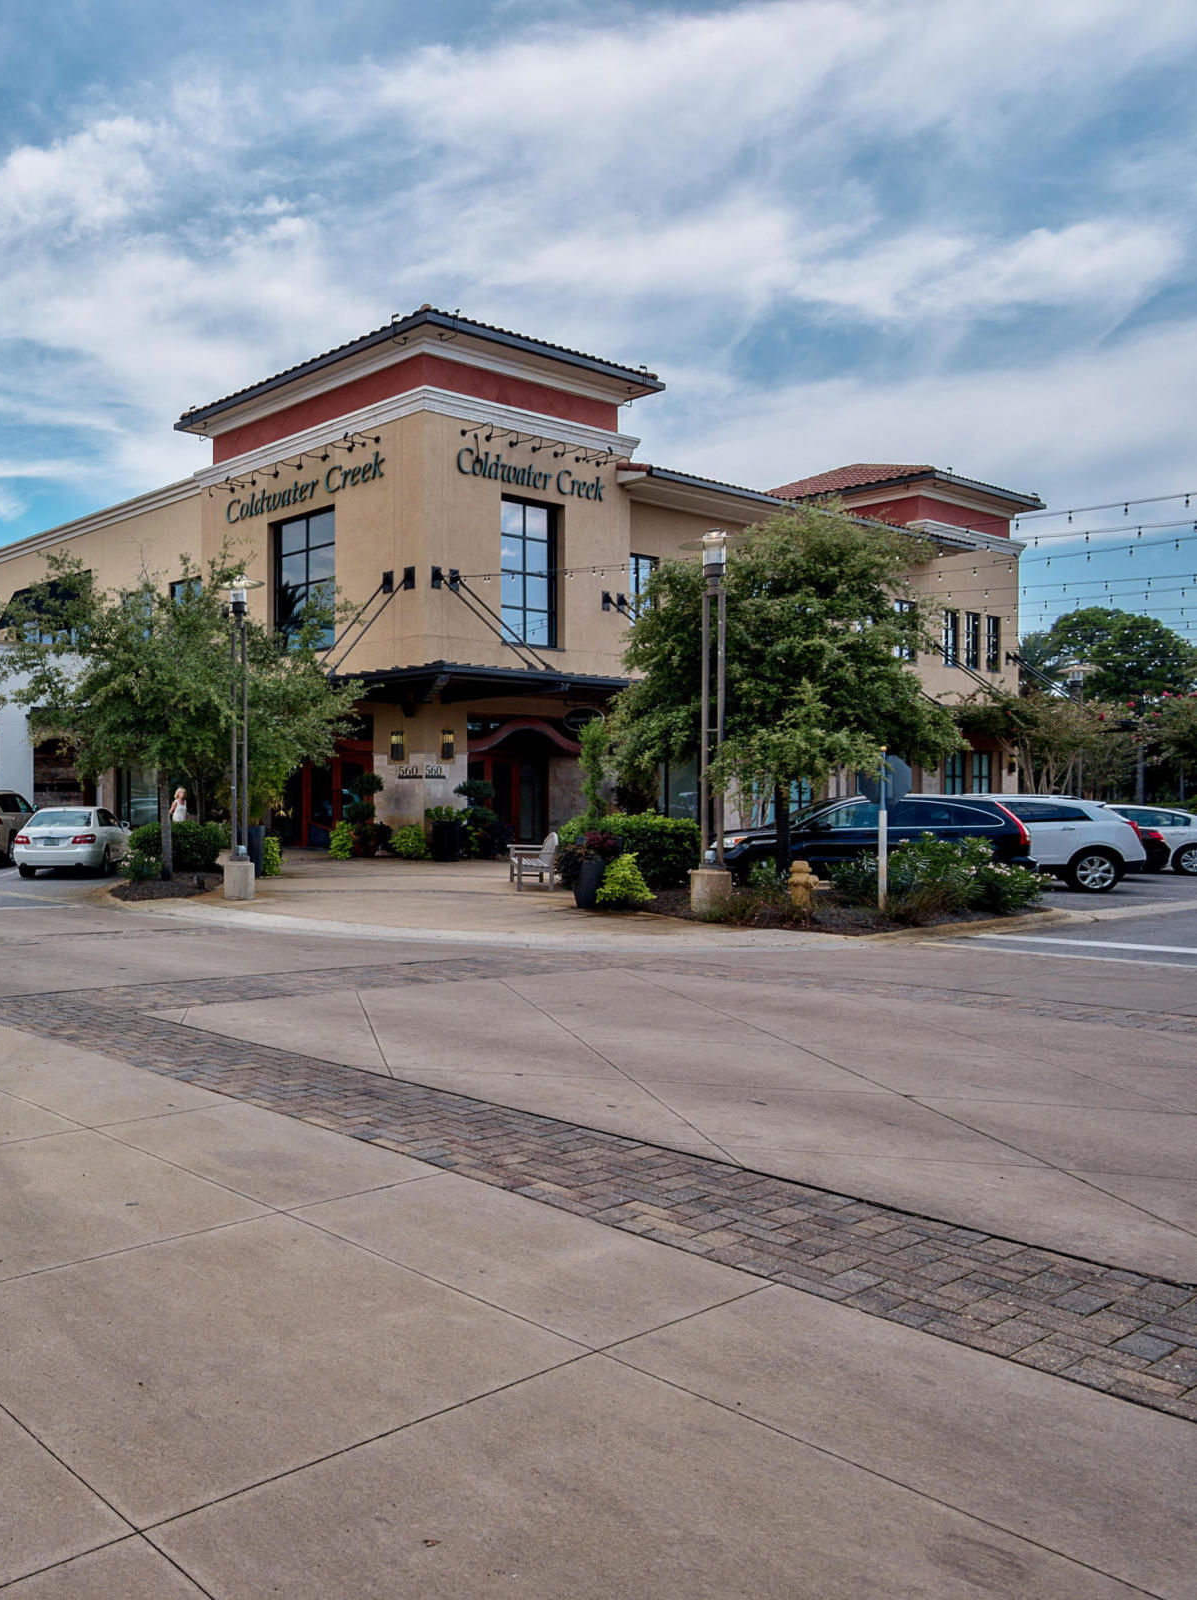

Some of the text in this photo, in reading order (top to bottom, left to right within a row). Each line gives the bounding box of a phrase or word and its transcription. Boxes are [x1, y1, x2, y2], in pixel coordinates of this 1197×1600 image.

[226, 450, 386, 524] Coldwater Creek
[457, 447, 605, 502] Coldwater Creek
[398, 765, 419, 776] 560
[425, 764, 443, 776] 560
